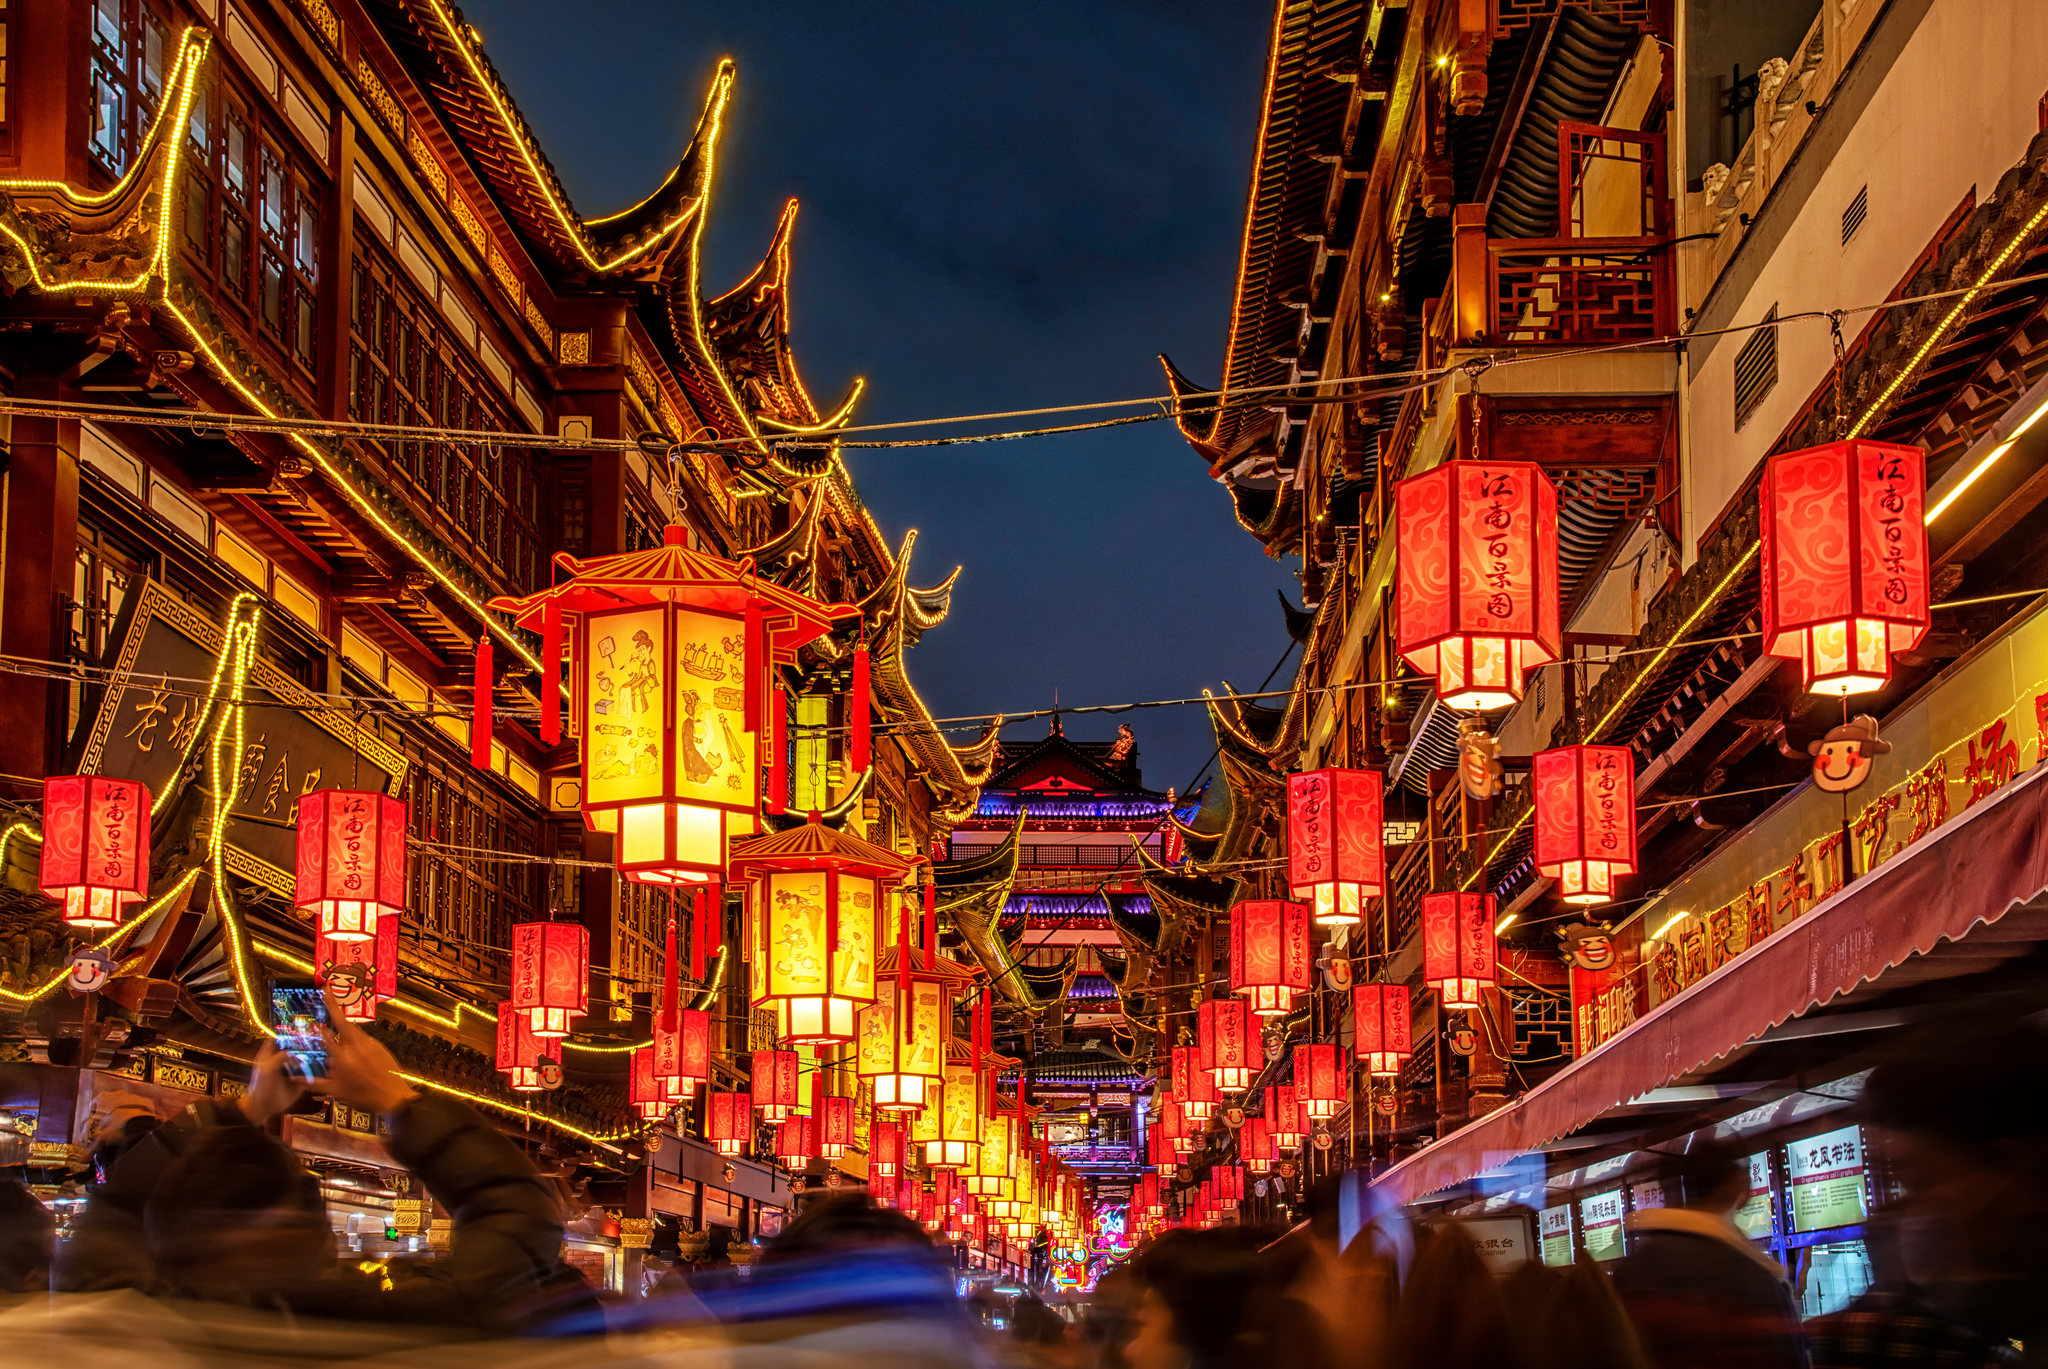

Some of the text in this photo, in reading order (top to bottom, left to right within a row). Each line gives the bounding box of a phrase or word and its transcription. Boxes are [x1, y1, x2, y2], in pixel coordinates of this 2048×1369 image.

[1481, 470, 1513, 619] 江南百景图
[1878, 452, 1907, 604] 江南百景图
[105, 783, 127, 878] 江南百景图
[1303, 777, 1322, 873] 江南百景图
[1596, 752, 1618, 850] 江南百景图
[344, 796, 366, 891] 江南百景图
[522, 928, 535, 1000] 江南百景图
[1292, 906, 1303, 980] 江南百景图
[664, 1034, 673, 1070] 百景图
[1224, 1003, 1237, 1062] 江南百景图
[1391, 987, 1404, 1047] 江南百景图
[782, 1053, 792, 1100] 江南百景图
[1284, 1087, 1294, 1130] 江南百景图
[1809, 1141, 1855, 1169] 龙凤书法
[1480, 1248, 1507, 1257] Cashier
